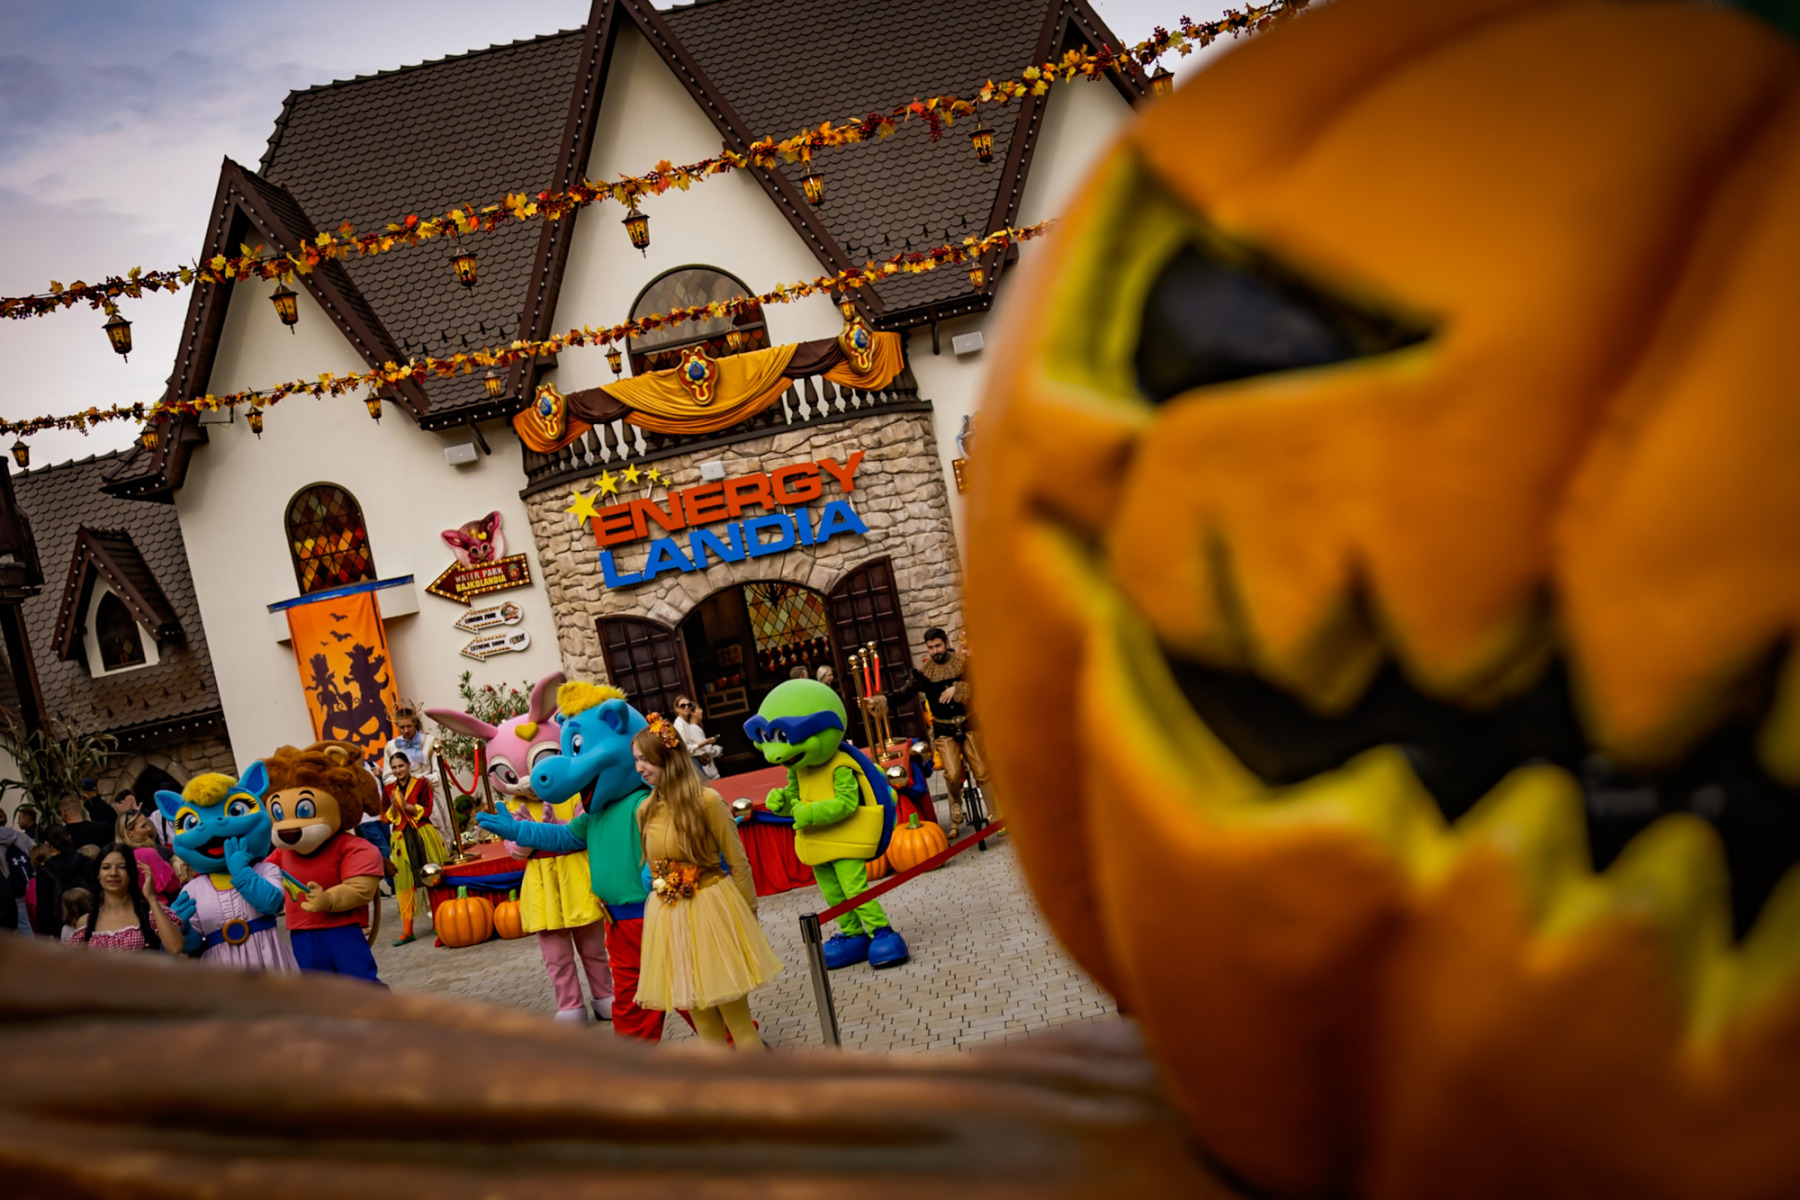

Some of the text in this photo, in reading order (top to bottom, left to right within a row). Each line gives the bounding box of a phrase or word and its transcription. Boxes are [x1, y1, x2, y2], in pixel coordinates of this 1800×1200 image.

[590, 450, 866, 547] ENERGY
[599, 499, 869, 588] LANDIA
[455, 571, 480, 583] WATER
[482, 567, 504, 578] PARK
[455, 574, 507, 592] BAJKOLANDIA
[470, 639, 505, 652] EXTREME SHOW
